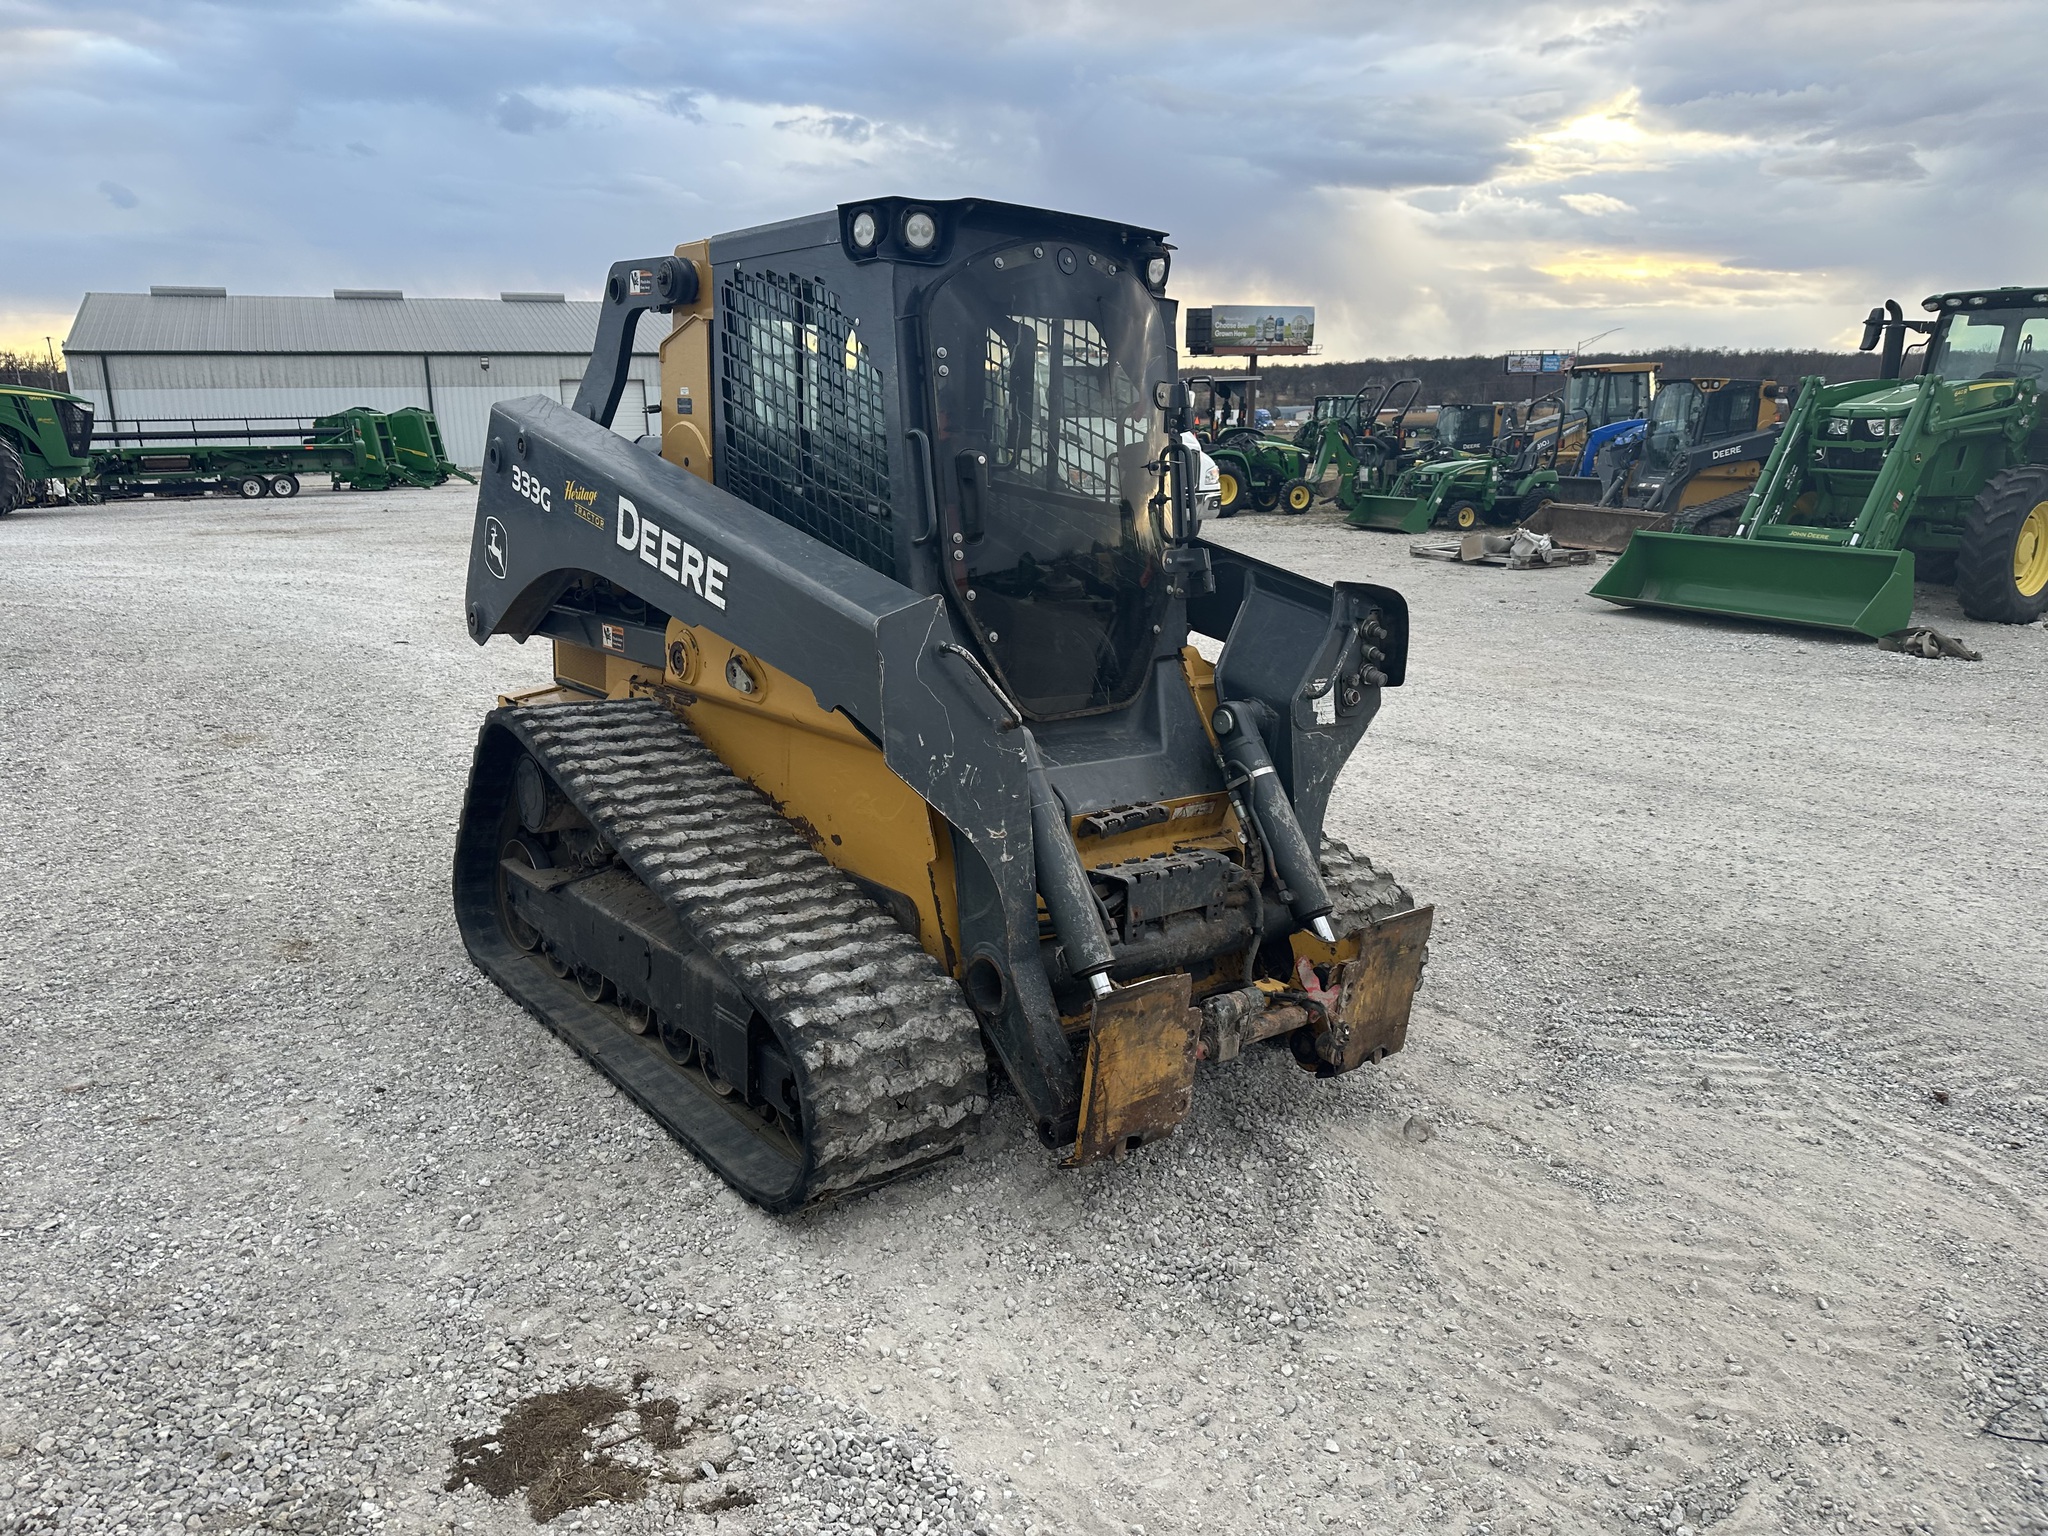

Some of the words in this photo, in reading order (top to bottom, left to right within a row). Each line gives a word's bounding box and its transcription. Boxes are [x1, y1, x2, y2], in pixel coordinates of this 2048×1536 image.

[1214, 321, 1237, 329] Choose
[1712, 446, 1742, 460] DEERE
[511, 464, 552, 513] 333G
[564, 479, 598, 506] Heritage
[573, 503, 606, 529] TRACTOR
[1789, 530, 1807, 538] JOHN
[1807, 532, 1830, 540] DEERE
[616, 494, 729, 611] DEERE
